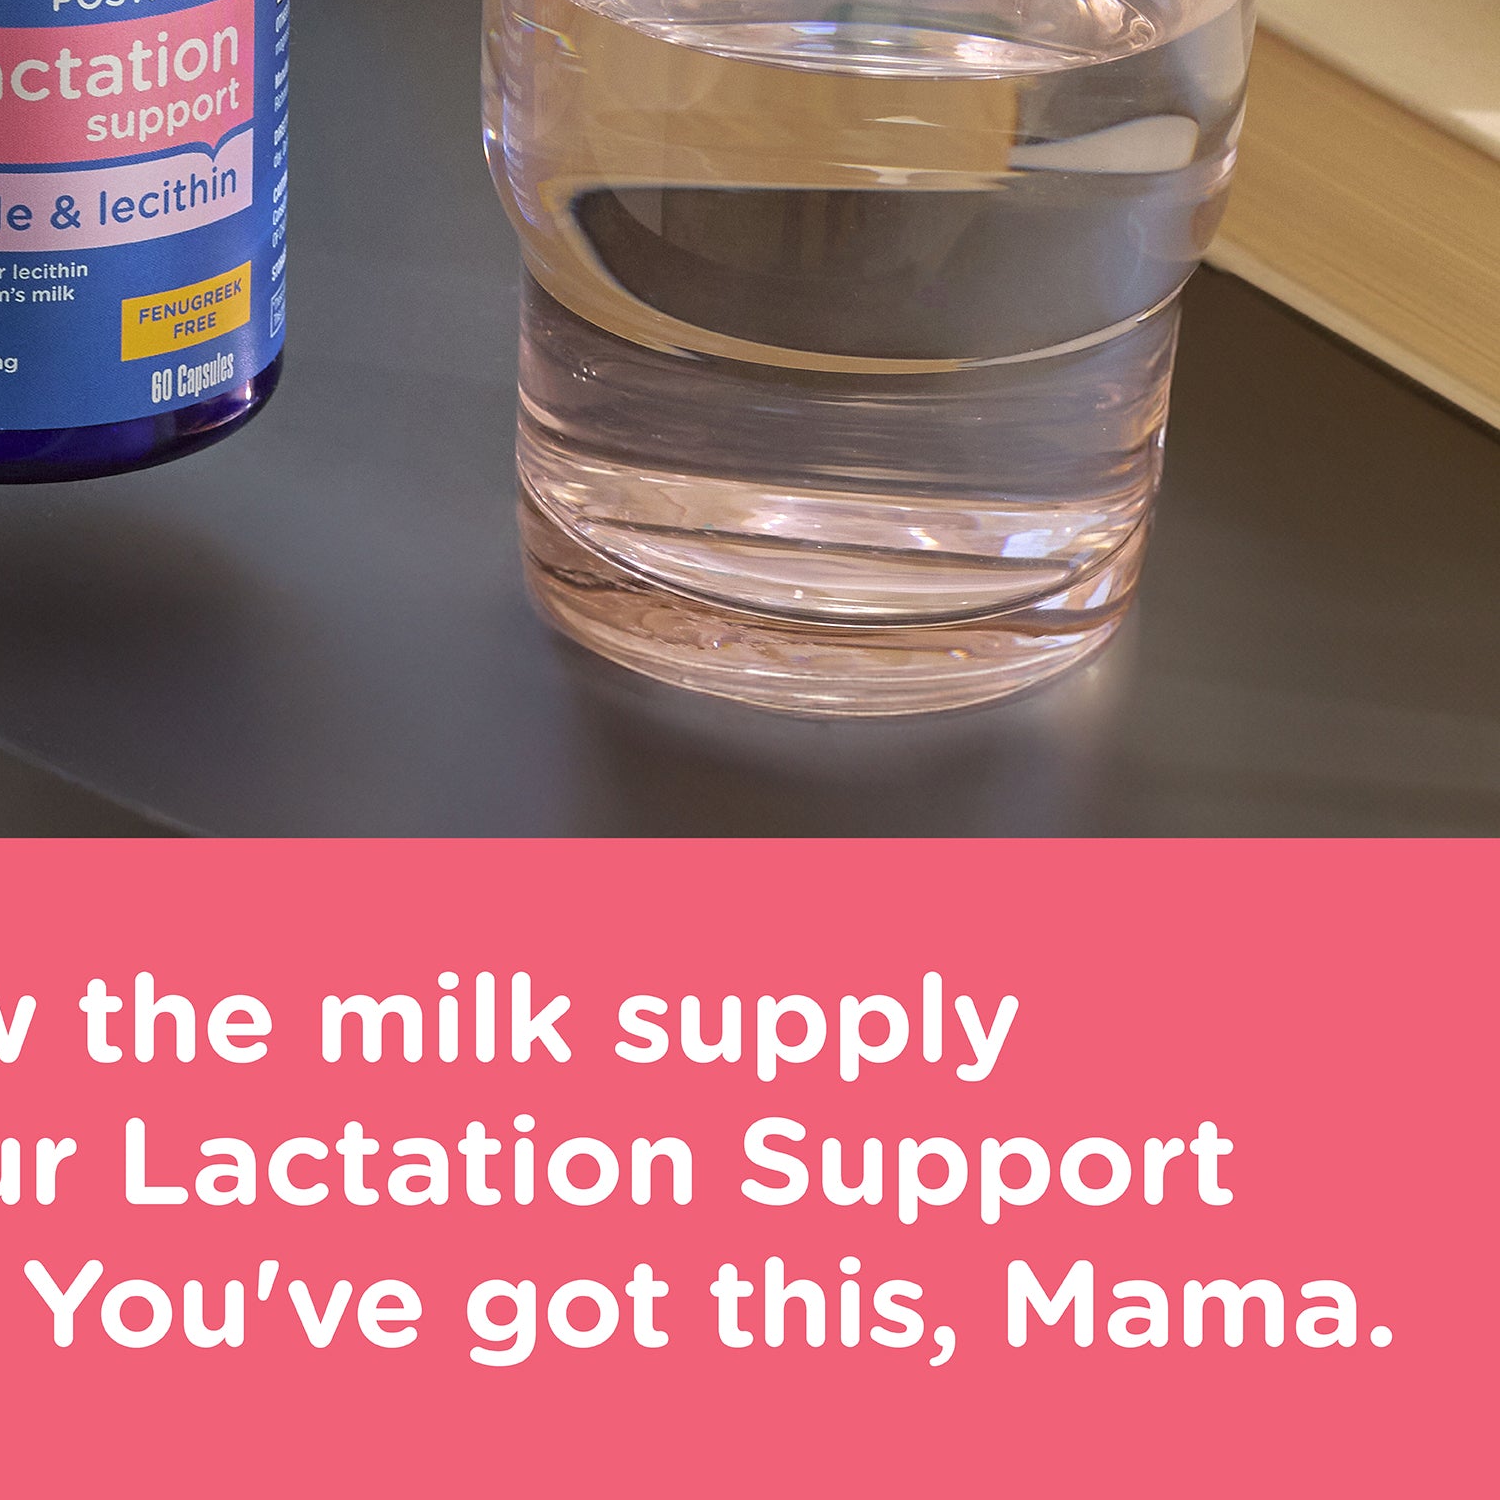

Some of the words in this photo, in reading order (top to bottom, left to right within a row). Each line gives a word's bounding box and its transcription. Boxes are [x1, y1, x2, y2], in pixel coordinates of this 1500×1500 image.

[86, 76, 240, 143] support
[50, 194, 81, 230] &
[99, 167, 237, 226] lecithin
[13, 262, 88, 280] lecithin
[32, 285, 75, 303] milk
[138, 277, 243, 326] FENUGREEK
[173, 311, 217, 340] FREE
[151, 368, 173, 404] 60
[177, 352, 235, 398] Capsules
